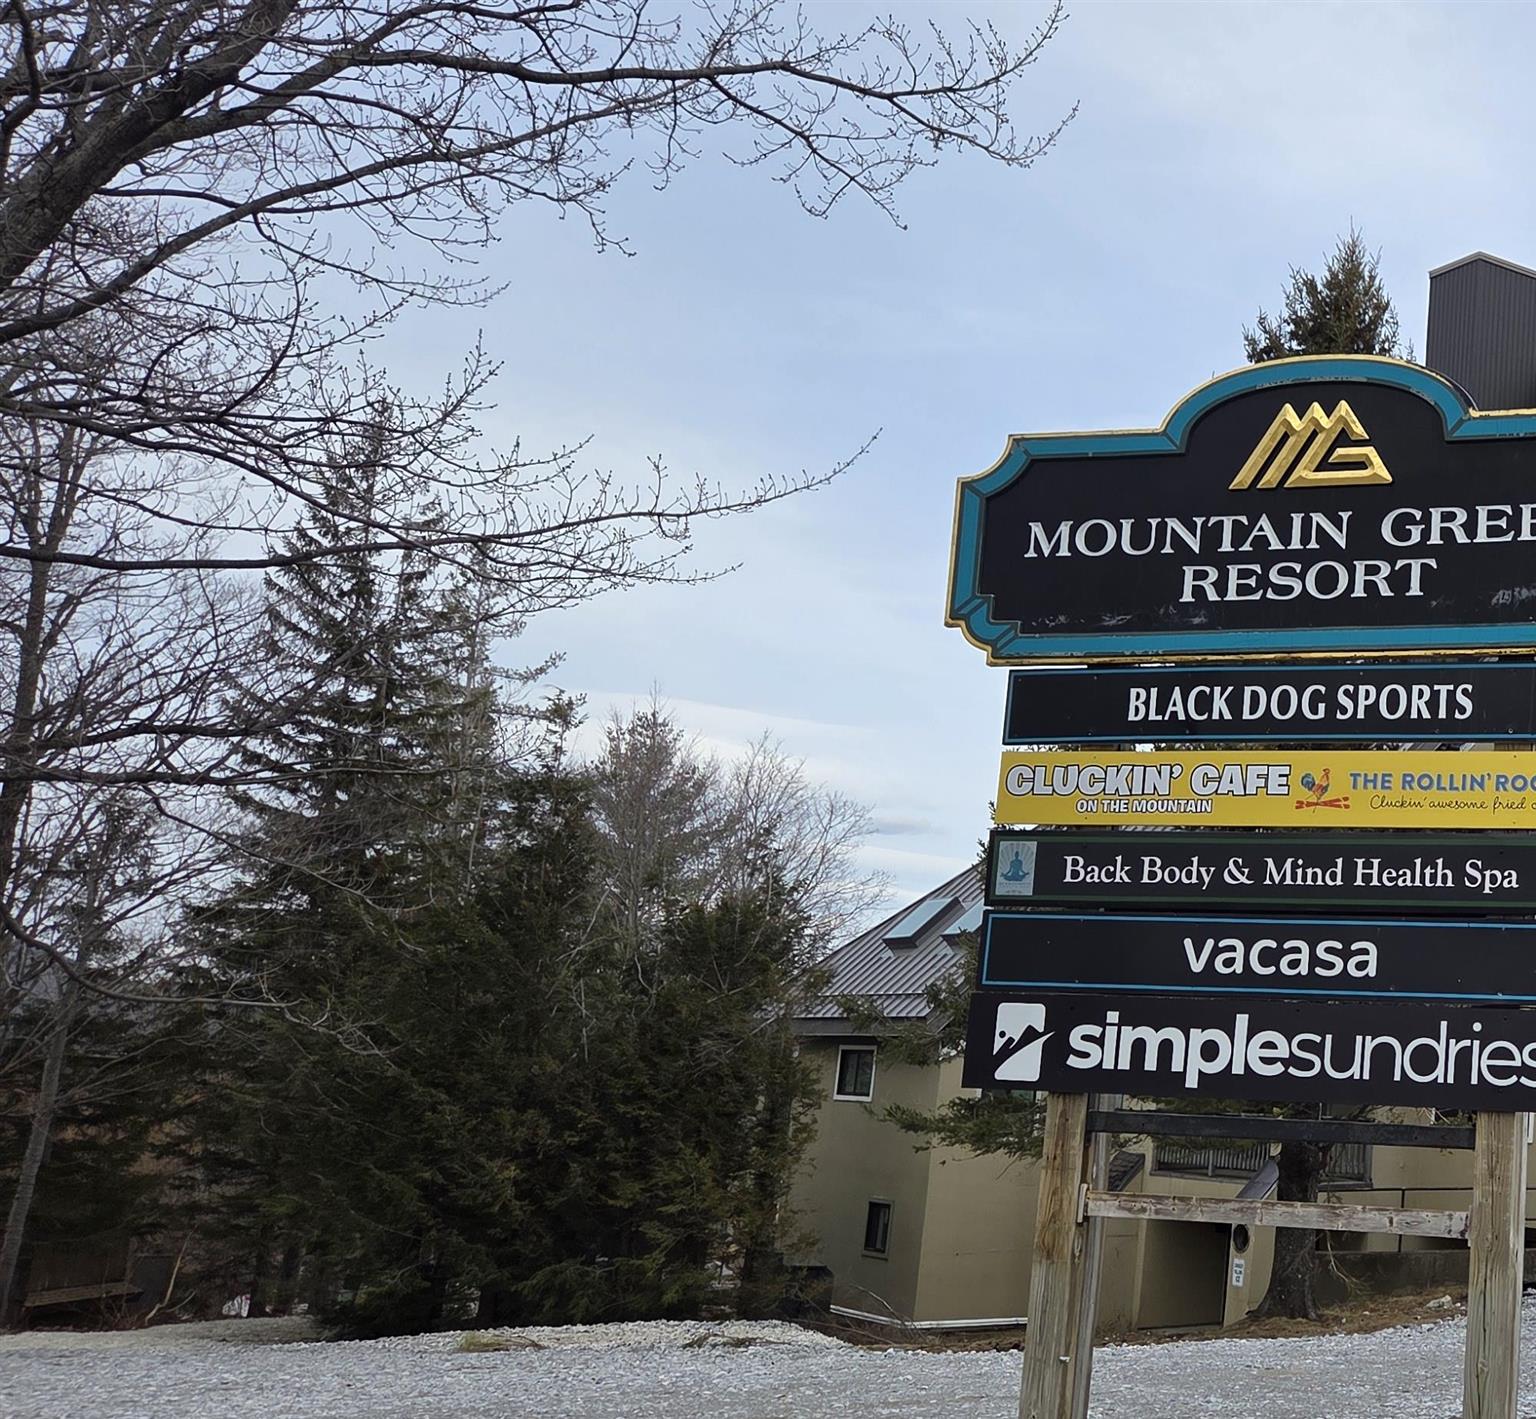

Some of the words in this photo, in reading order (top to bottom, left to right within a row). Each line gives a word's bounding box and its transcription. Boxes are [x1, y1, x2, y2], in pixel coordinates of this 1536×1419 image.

[1024, 510, 1351, 558] MOUNTAIN
[1179, 558, 1438, 603] RESORT
[1126, 684, 1234, 722] BLACK
[1242, 684, 1327, 720] DOG
[1336, 682, 1475, 719] SPORTS
[1005, 764, 1184, 797] CLUCKIN'
[1190, 764, 1292, 796] CAFE
[1350, 772, 1393, 791] THE
[1401, 772, 1491, 793] ROLLIN'
[1075, 799, 1098, 813] ON
[1101, 799, 1129, 813] THE
[1132, 799, 1213, 814] MOUNTAIN
[1369, 794, 1427, 811] Cluckin'
[1429, 799, 1488, 810] awesome
[1492, 796, 1527, 815] fried
[1063, 855, 1132, 884] Back
[1140, 856, 1216, 890] Body
[1223, 857, 1255, 886] &
[1263, 857, 1344, 887] Mind
[1353, 857, 1455, 888] Health
[1464, 859, 1520, 894] Spa
[1182, 937, 1379, 979] vacasa
